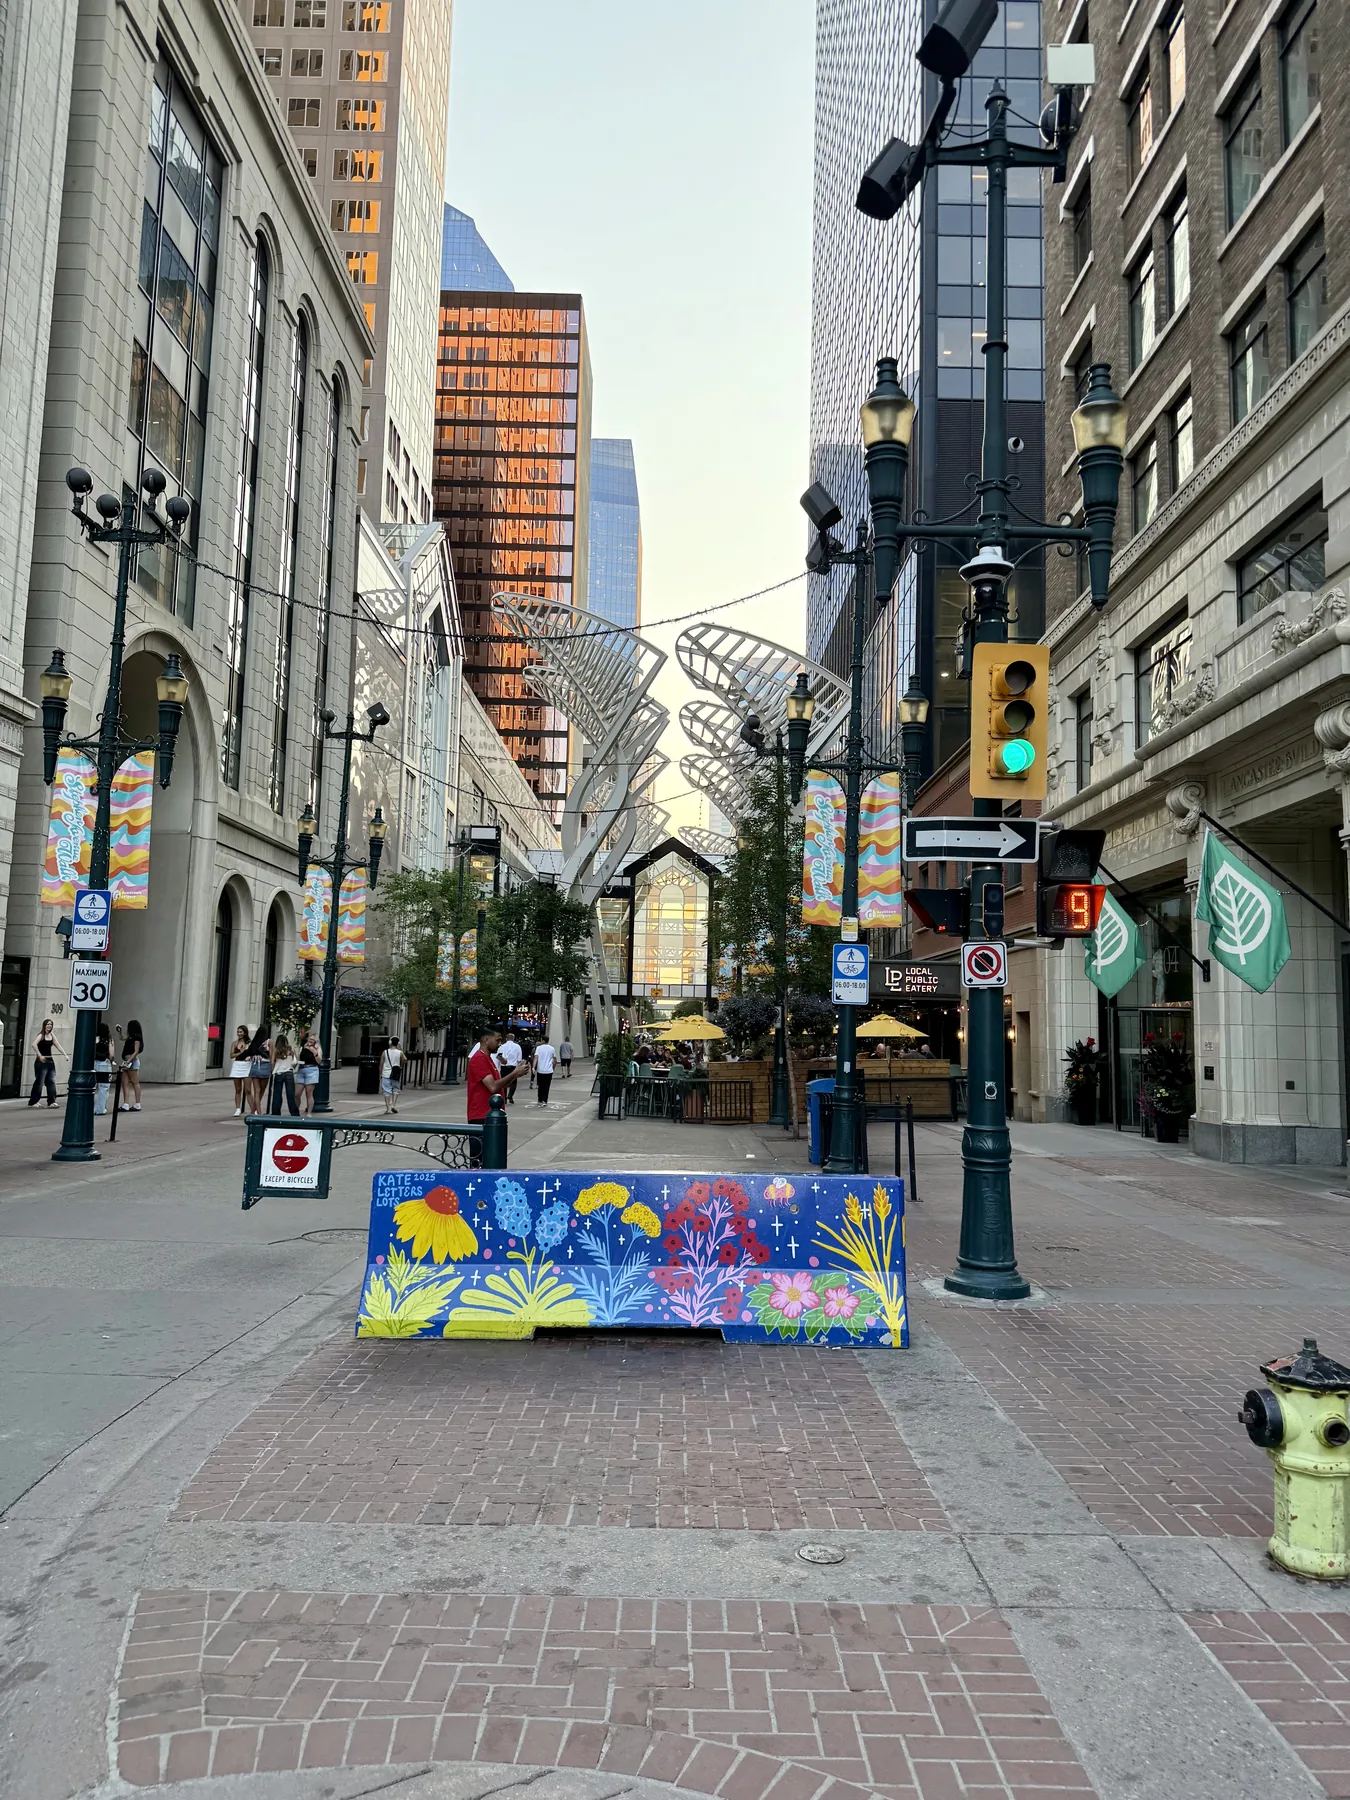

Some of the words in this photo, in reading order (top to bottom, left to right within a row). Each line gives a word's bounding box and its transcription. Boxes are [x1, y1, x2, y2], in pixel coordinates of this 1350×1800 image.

[1223, 757, 1281, 797] LANCASTER
[63, 773, 88, 826] Stephen
[814, 794, 839, 846] Stephen
[63, 812, 84, 862] Avenue
[57, 839, 78, 881] Walk
[814, 832, 837, 882] Avenue
[811, 859, 833, 901] Walk
[75, 927, 106, 936] 06:00-18:00
[75, 969, 107, 977] MAXIMUM
[905, 967, 932, 976] LOCAL
[905, 976, 939, 985] PUBLIC
[73, 982, 106, 1003] 30
[905, 985, 938, 993] EATERY
[51, 1002, 64, 1014] 309
[508, 1004, 528, 1012] Erls
[264, 1175, 286, 1183] EXCEPT
[287, 1176, 314, 1184] BICYCLES
[378, 1174, 412, 1187] KATE
[414, 1173, 436, 1181] 2025
[377, 1186, 423, 1198] LETTERS
[376, 1197, 400, 1208] LOTS
